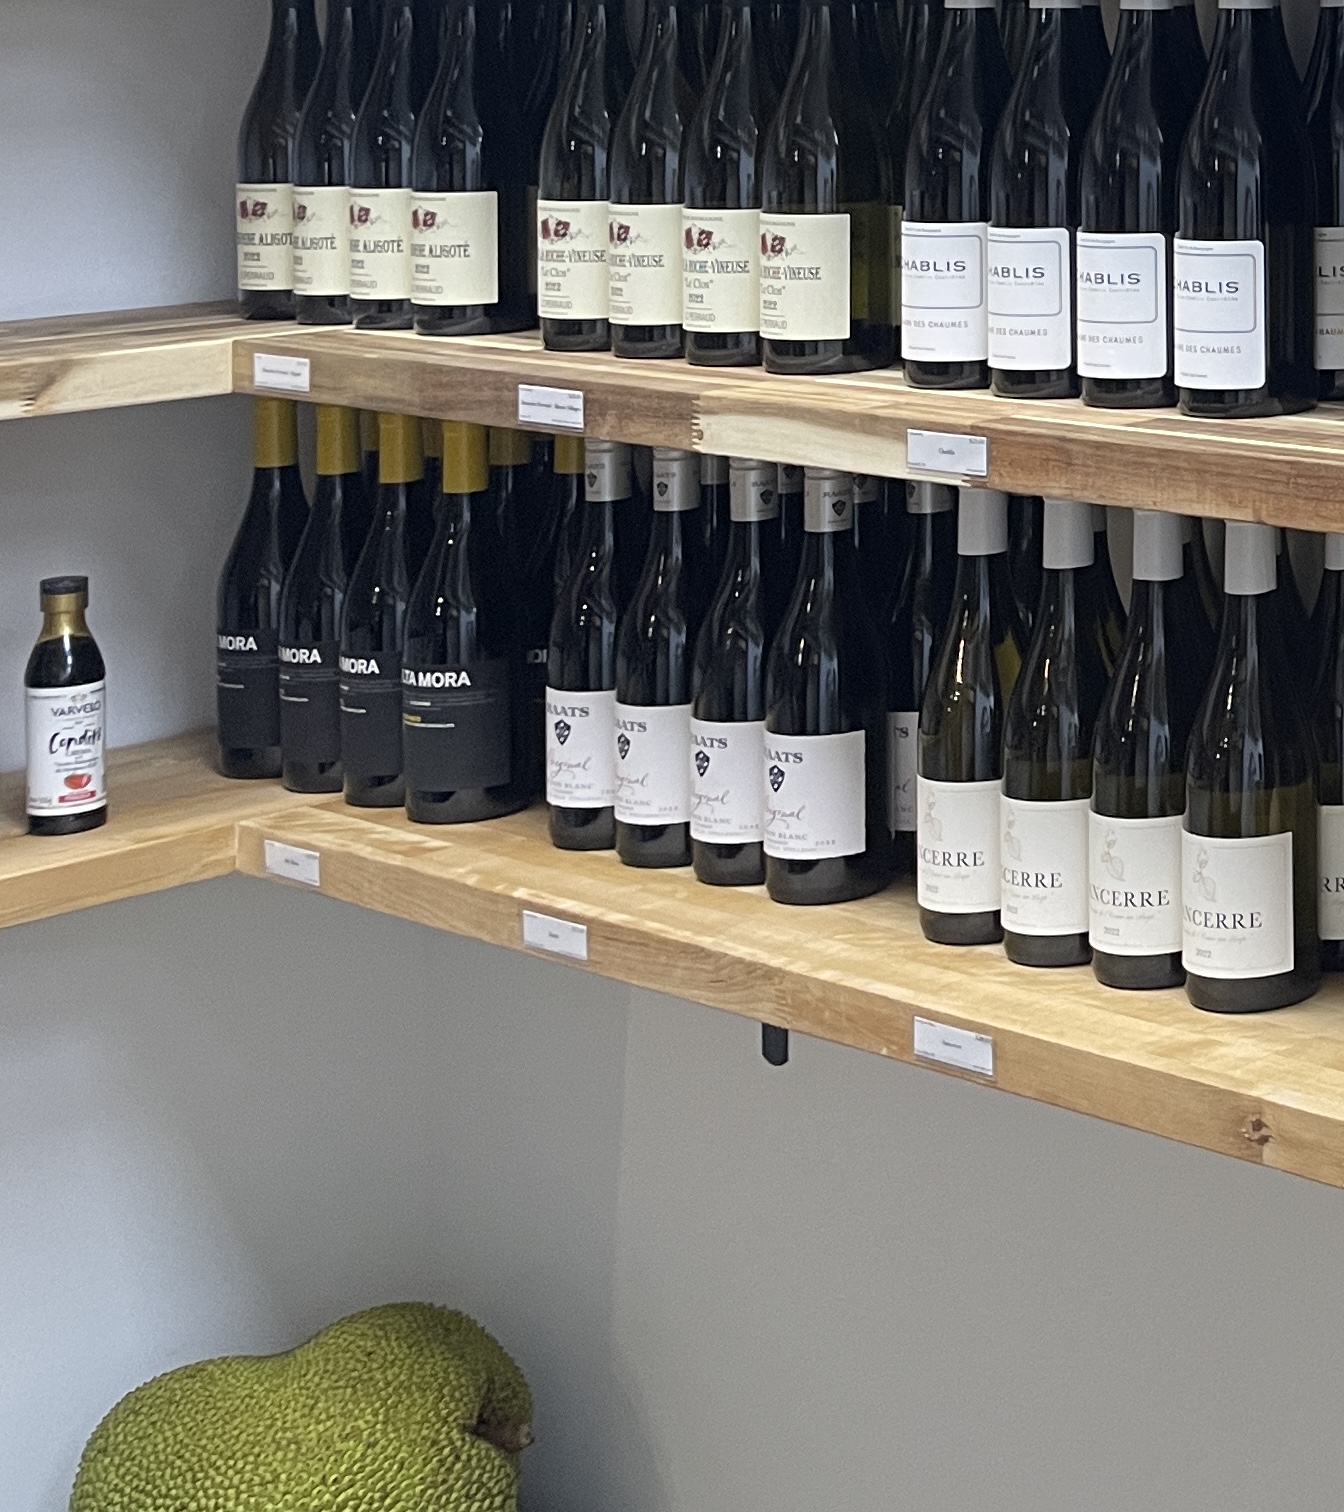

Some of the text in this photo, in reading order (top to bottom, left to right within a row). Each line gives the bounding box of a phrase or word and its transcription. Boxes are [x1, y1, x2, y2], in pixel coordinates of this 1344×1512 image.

[1174, 281, 1239, 294] HABLIS
[418, 671, 471, 687] MORA
[1184, 905, 1263, 929] NCERRE
